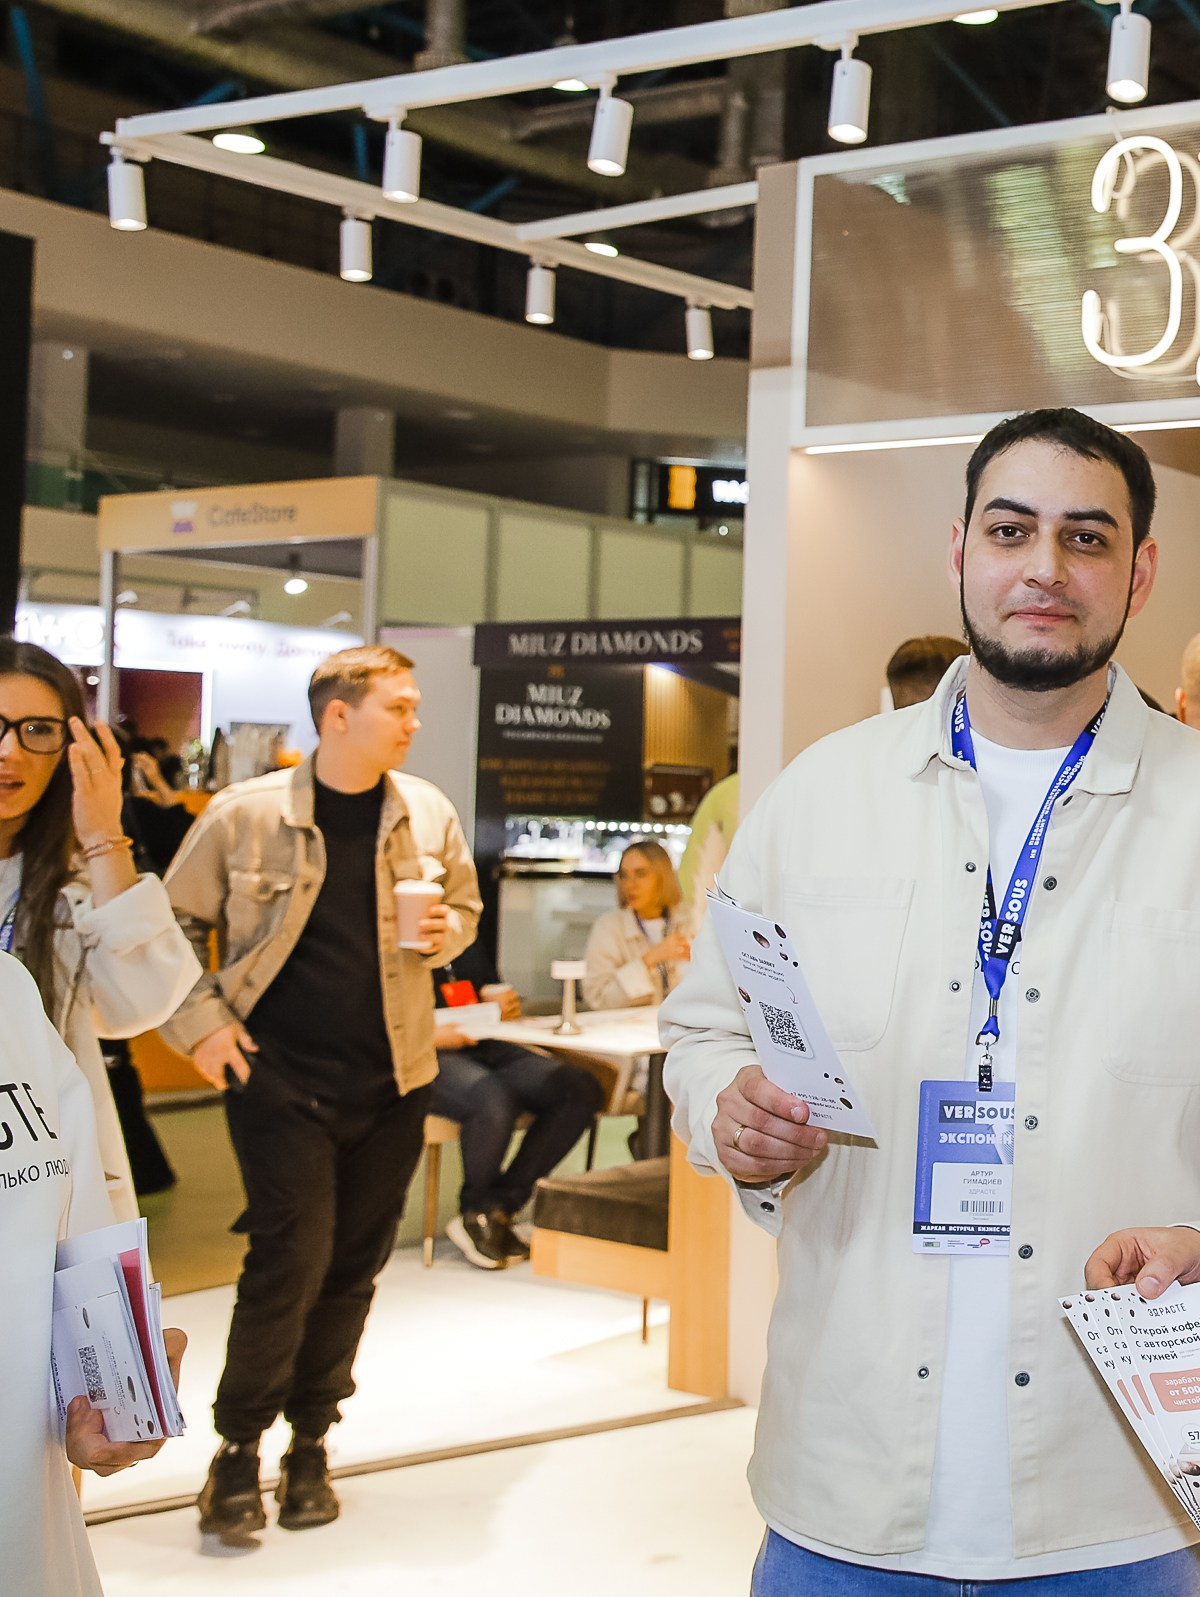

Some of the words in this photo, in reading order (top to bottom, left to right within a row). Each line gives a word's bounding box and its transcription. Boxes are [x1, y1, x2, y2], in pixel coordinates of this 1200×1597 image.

[508, 632, 566, 657] MIUZ
[570, 629, 703, 656] DIAMONDS
[527, 683, 583, 707] MIUZ
[495, 703, 612, 730] DIAMONDS
[1148, 1303, 1187, 1317] ЗДРАСТЕ
[1130, 1325, 1169, 1337] Открой
[1144, 1333, 1200, 1348] авторской
[1141, 1351, 1178, 1363] кухней
[1174, 1396, 1200, 1406] чистой
[1188, 1431, 1200, 1441] 57
